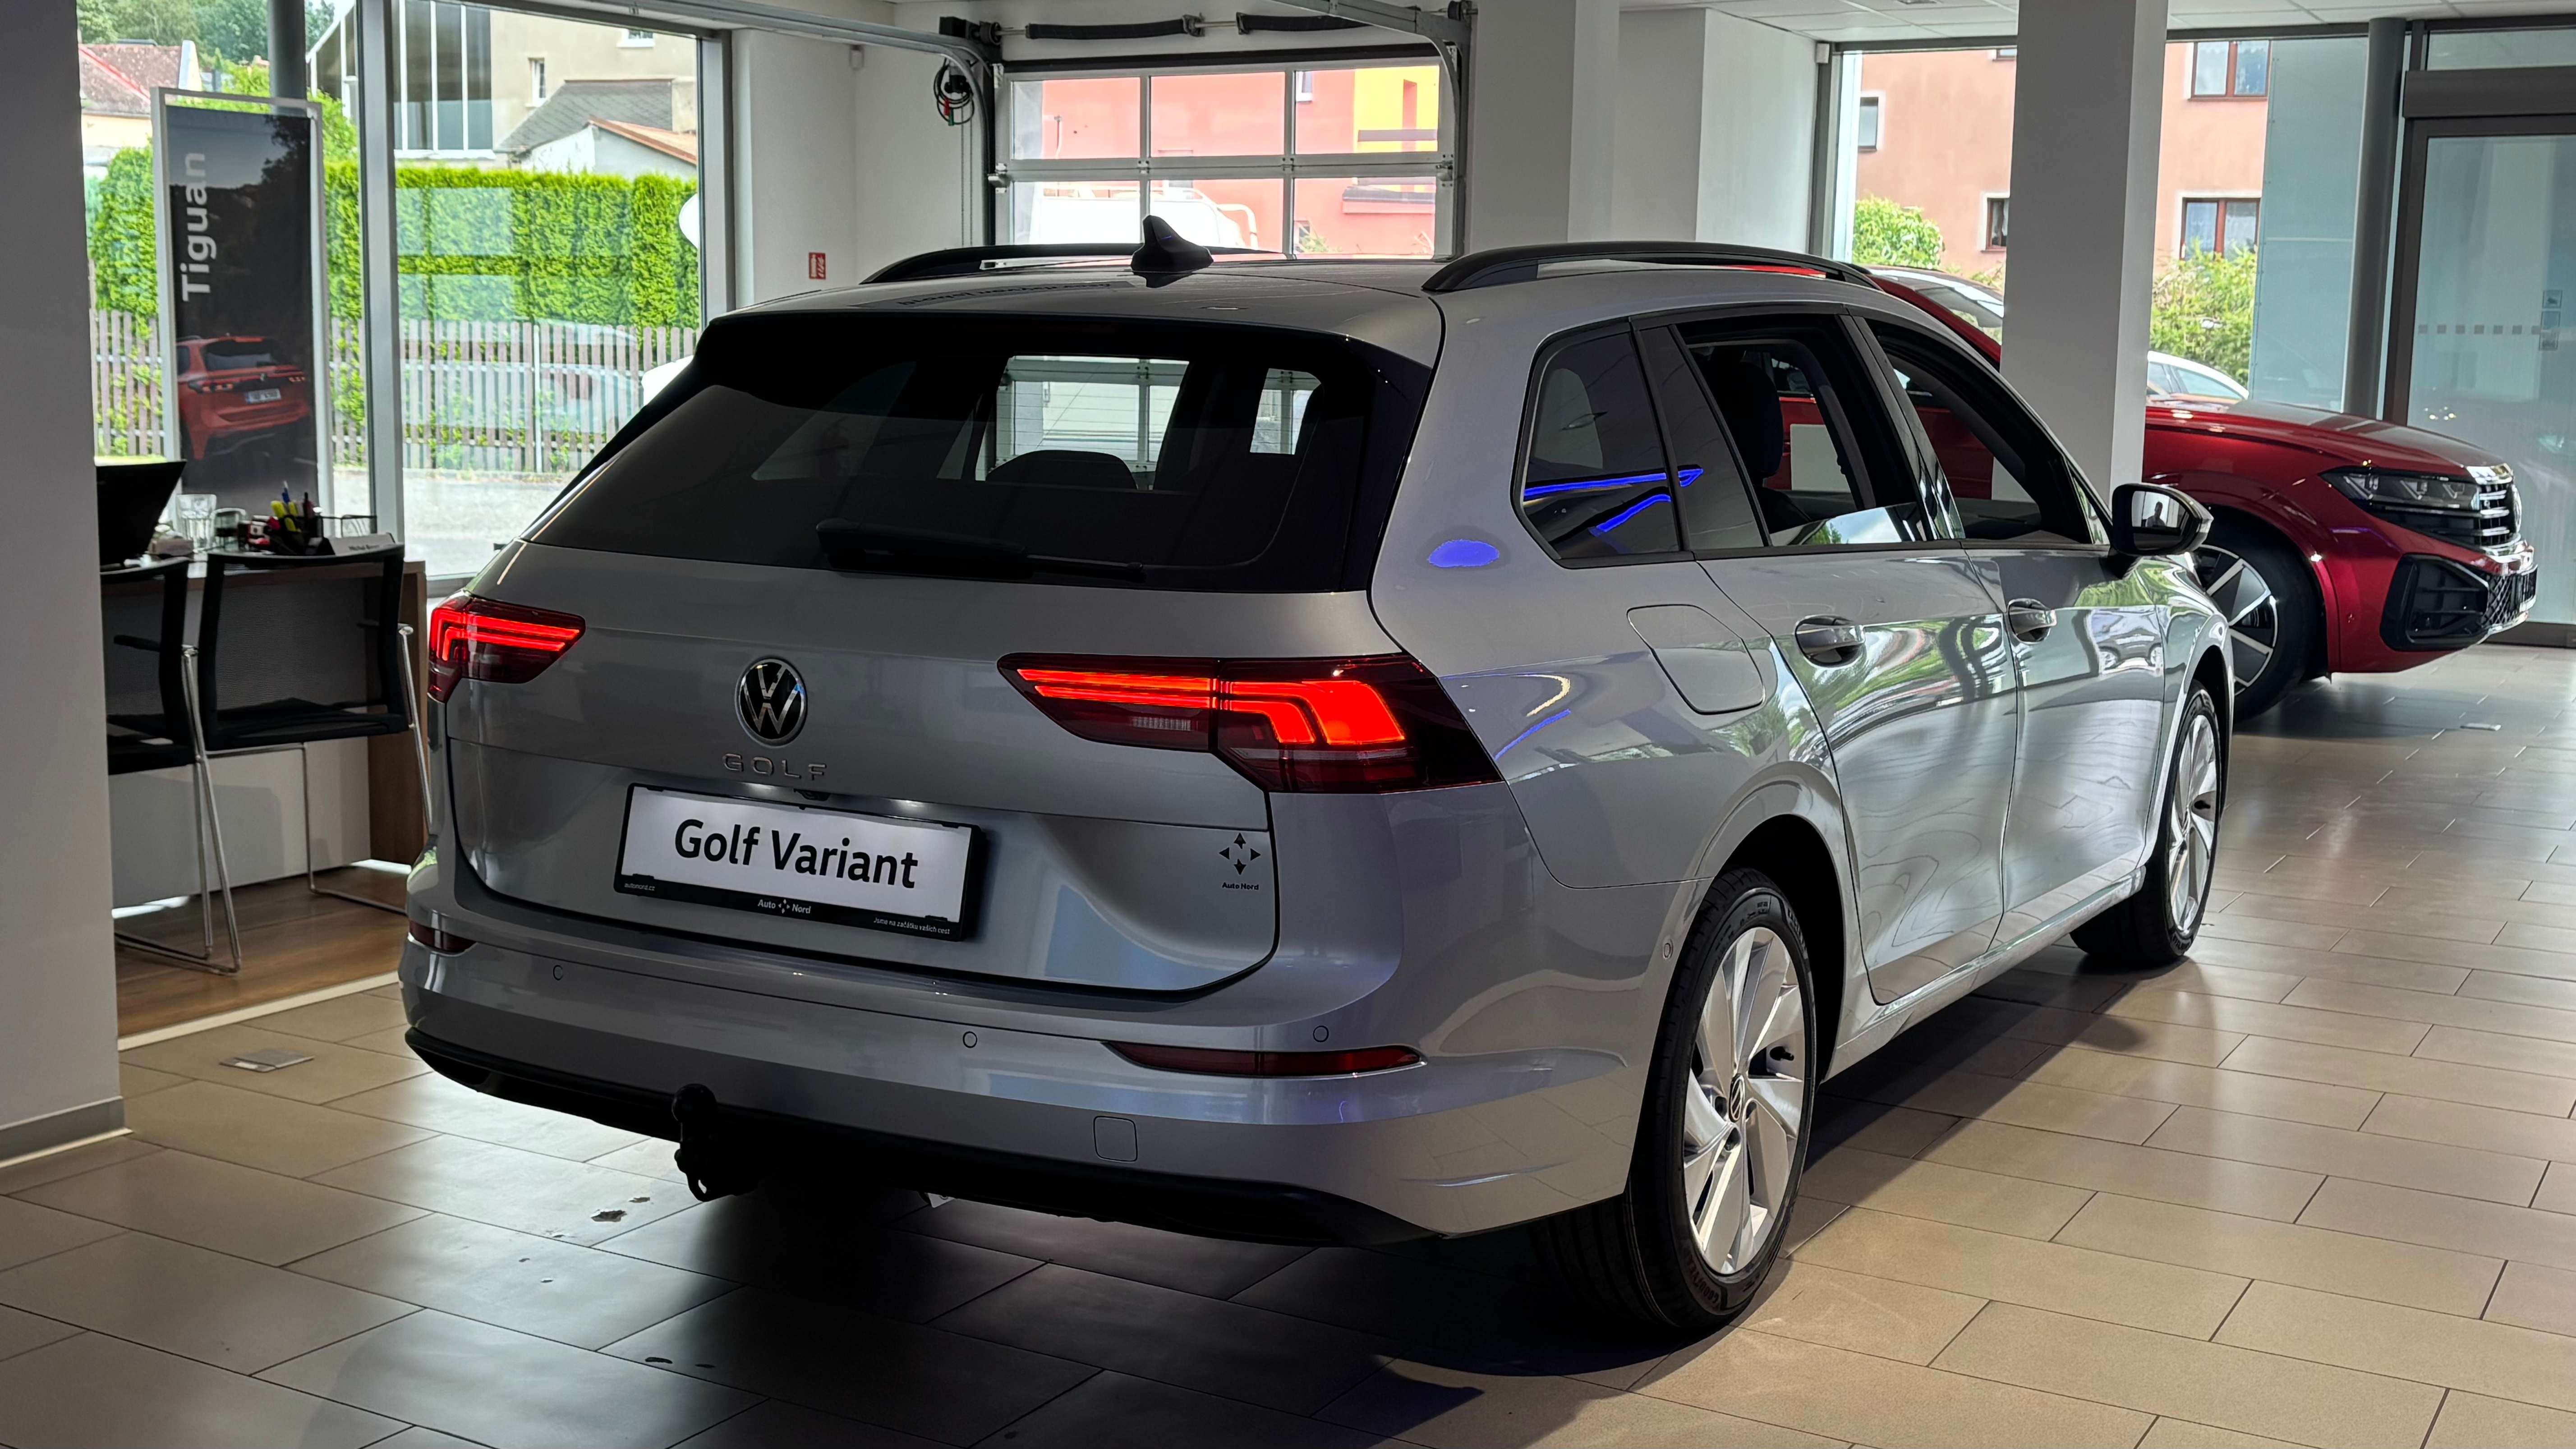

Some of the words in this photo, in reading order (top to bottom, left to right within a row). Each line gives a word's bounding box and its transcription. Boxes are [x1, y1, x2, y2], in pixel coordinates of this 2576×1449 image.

[179, 153, 216, 302] Tiguan
[740, 659, 805, 740] VW
[722, 753, 827, 780] GOLF
[675, 819, 760, 865] Golf
[771, 830, 918, 889] Variant
[758, 899, 776, 909] Auto
[792, 903, 811, 914] Nord
